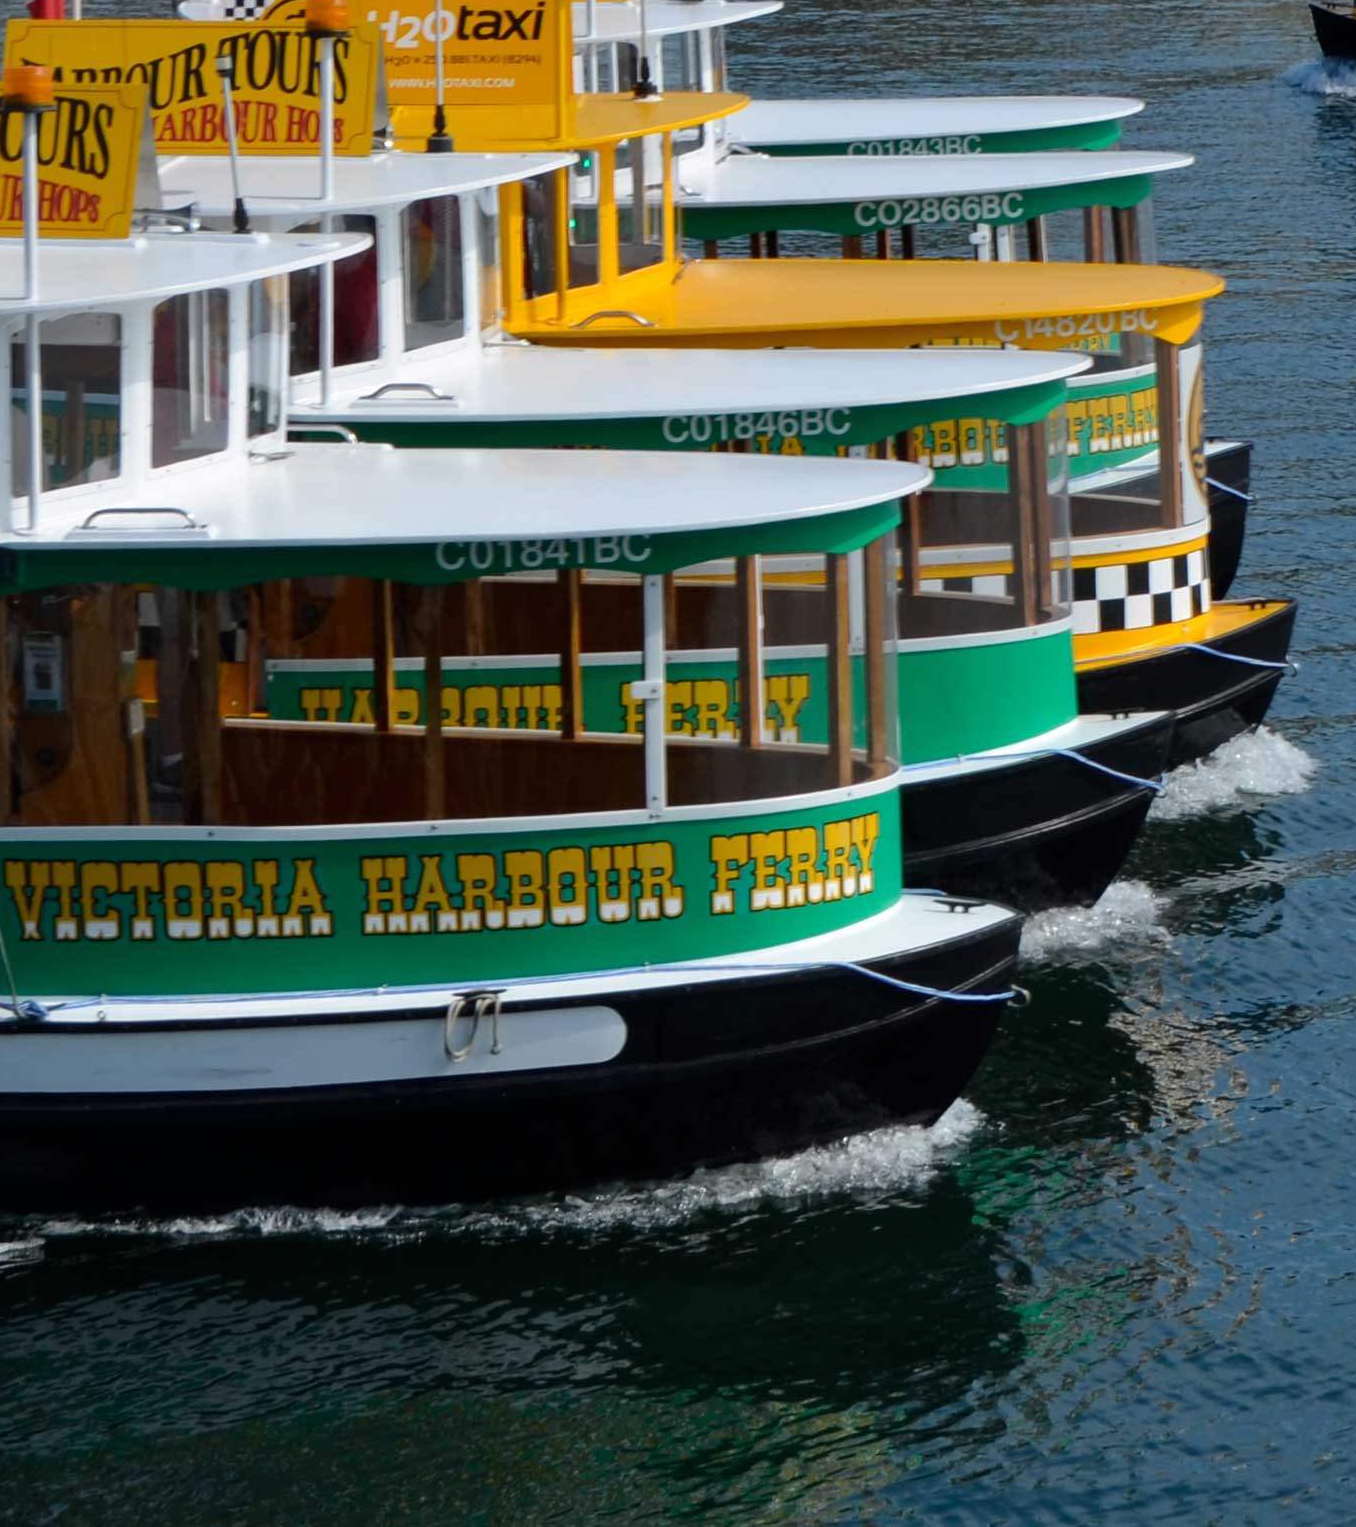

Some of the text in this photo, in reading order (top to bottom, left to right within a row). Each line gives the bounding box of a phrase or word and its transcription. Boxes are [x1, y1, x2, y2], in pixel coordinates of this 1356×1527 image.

[368, 1, 546, 49] H2Otaxi
[3, 812, 881, 940] VICTORIA HARBOUR FERRY
